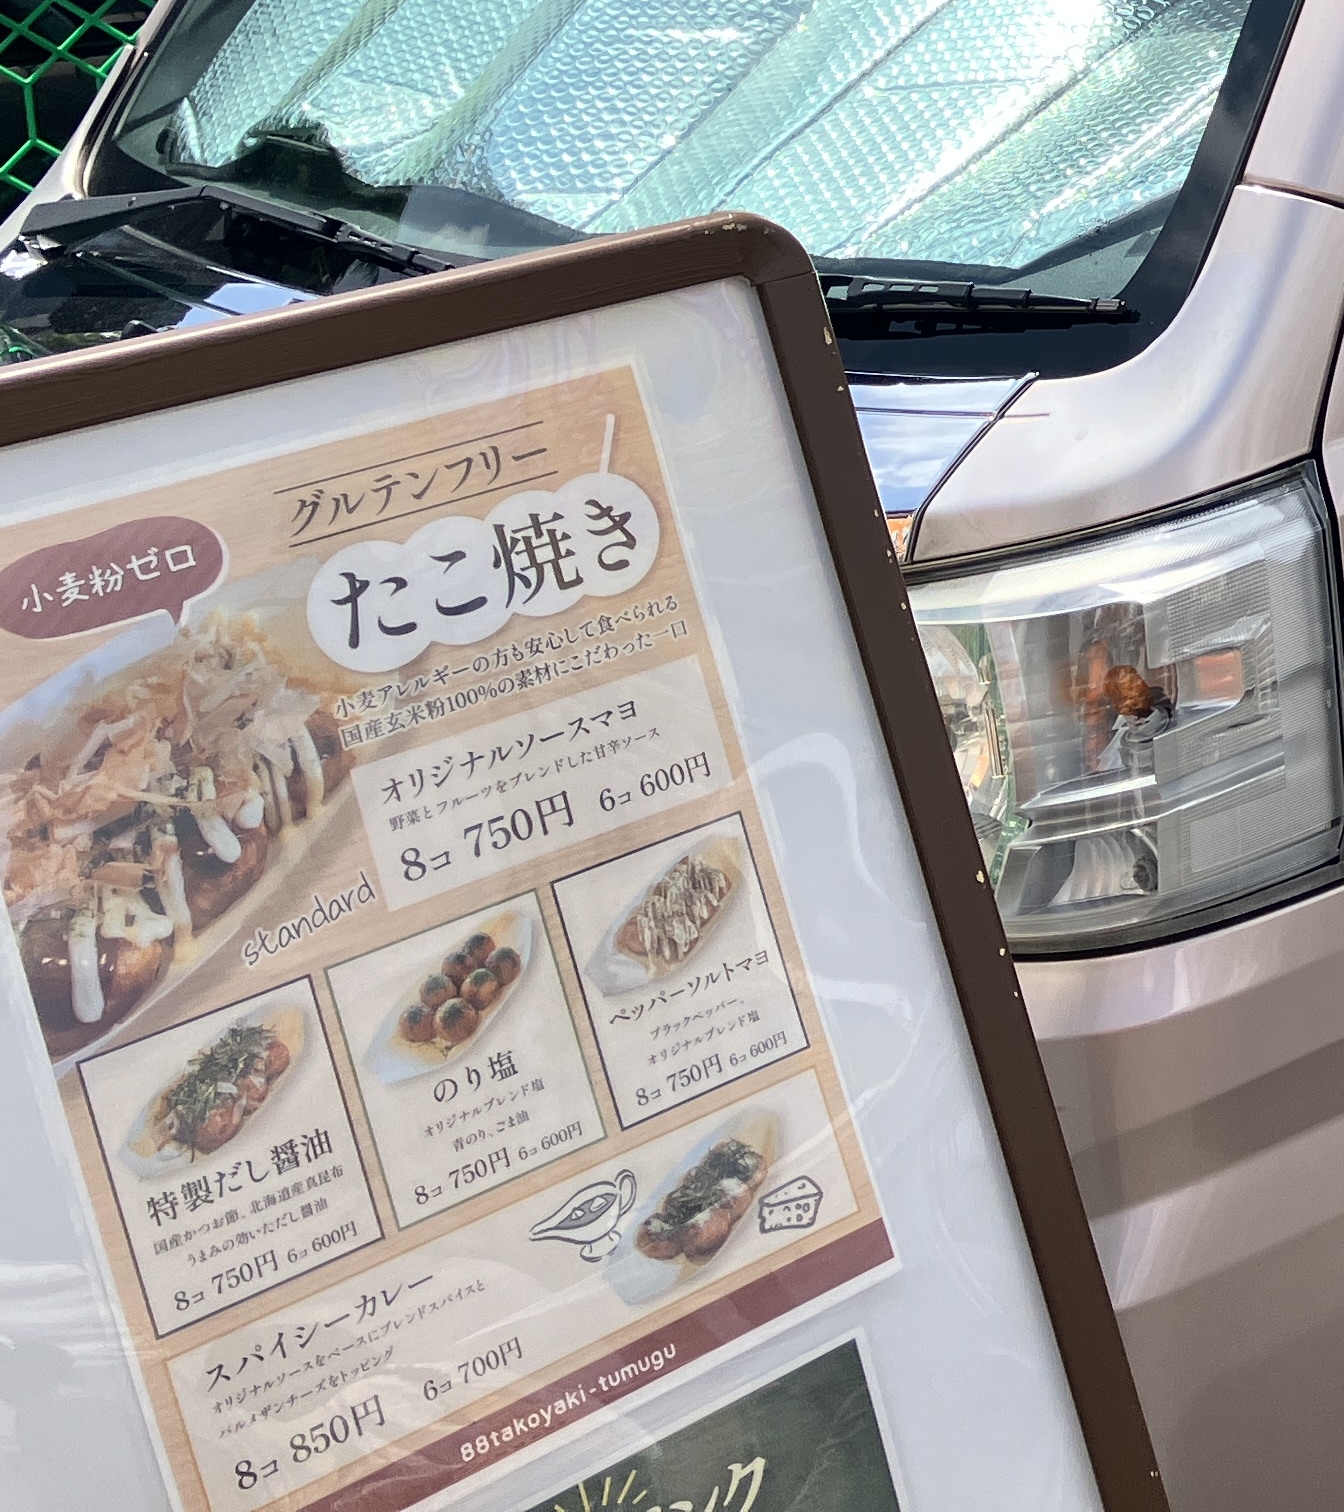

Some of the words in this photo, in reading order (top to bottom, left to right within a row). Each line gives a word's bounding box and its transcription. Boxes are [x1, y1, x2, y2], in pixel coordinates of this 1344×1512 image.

[290, 445, 548, 538] グルテンフリー
[21, 544, 197, 613] 小麦粉ゼロ
[330, 497, 637, 650] たこ焼き
[335, 595, 679, 720] 小麦アレルギーの方も安心して食べられる
[340, 619, 689, 748] 国産玄米粉100%の素材にこだわった一口
[380, 699, 639, 806] オリジナルソースマヨ
[388, 726, 662, 833] 野菜とフルーツをブレンドした甘辛ソース
[400, 847, 453, 883] 8コ
[462, 790, 577, 860] 750円
[598, 787, 633, 813] 6コ
[638, 751, 713, 798] 600円
[242, 870, 377, 967] standard
[609, 949, 770, 1025] ペッパーソルトマヨ
[433, 1049, 520, 1104] のり塩
[635, 1087, 662, 1107] 8コ
[666, 1053, 724, 1093] 750円
[728, 1052, 748, 1068] 6コ
[749, 1030, 788, 1059] 600円
[146, 1127, 334, 1228] 特製だし醤油
[413, 1184, 443, 1206] 8コ
[447, 1147, 512, 1190] 750円
[517, 1145, 539, 1162] 6コ
[540, 1120, 584, 1151] 600円
[173, 1290, 206, 1312] 8コ
[210, 1248, 279, 1295] 750円
[286, 1247, 309, 1264] 6コ
[311, 1219, 358, 1253] 600円
[205, 1274, 435, 1393] スパイシーカレー
[234, 1457, 280, 1490] 8コ
[288, 1392, 387, 1464] 850円
[422, 1378, 454, 1403] 6コ
[457, 1335, 524, 1384] 700円
[459, 1339, 677, 1464] 88takoyaki-tumugu
